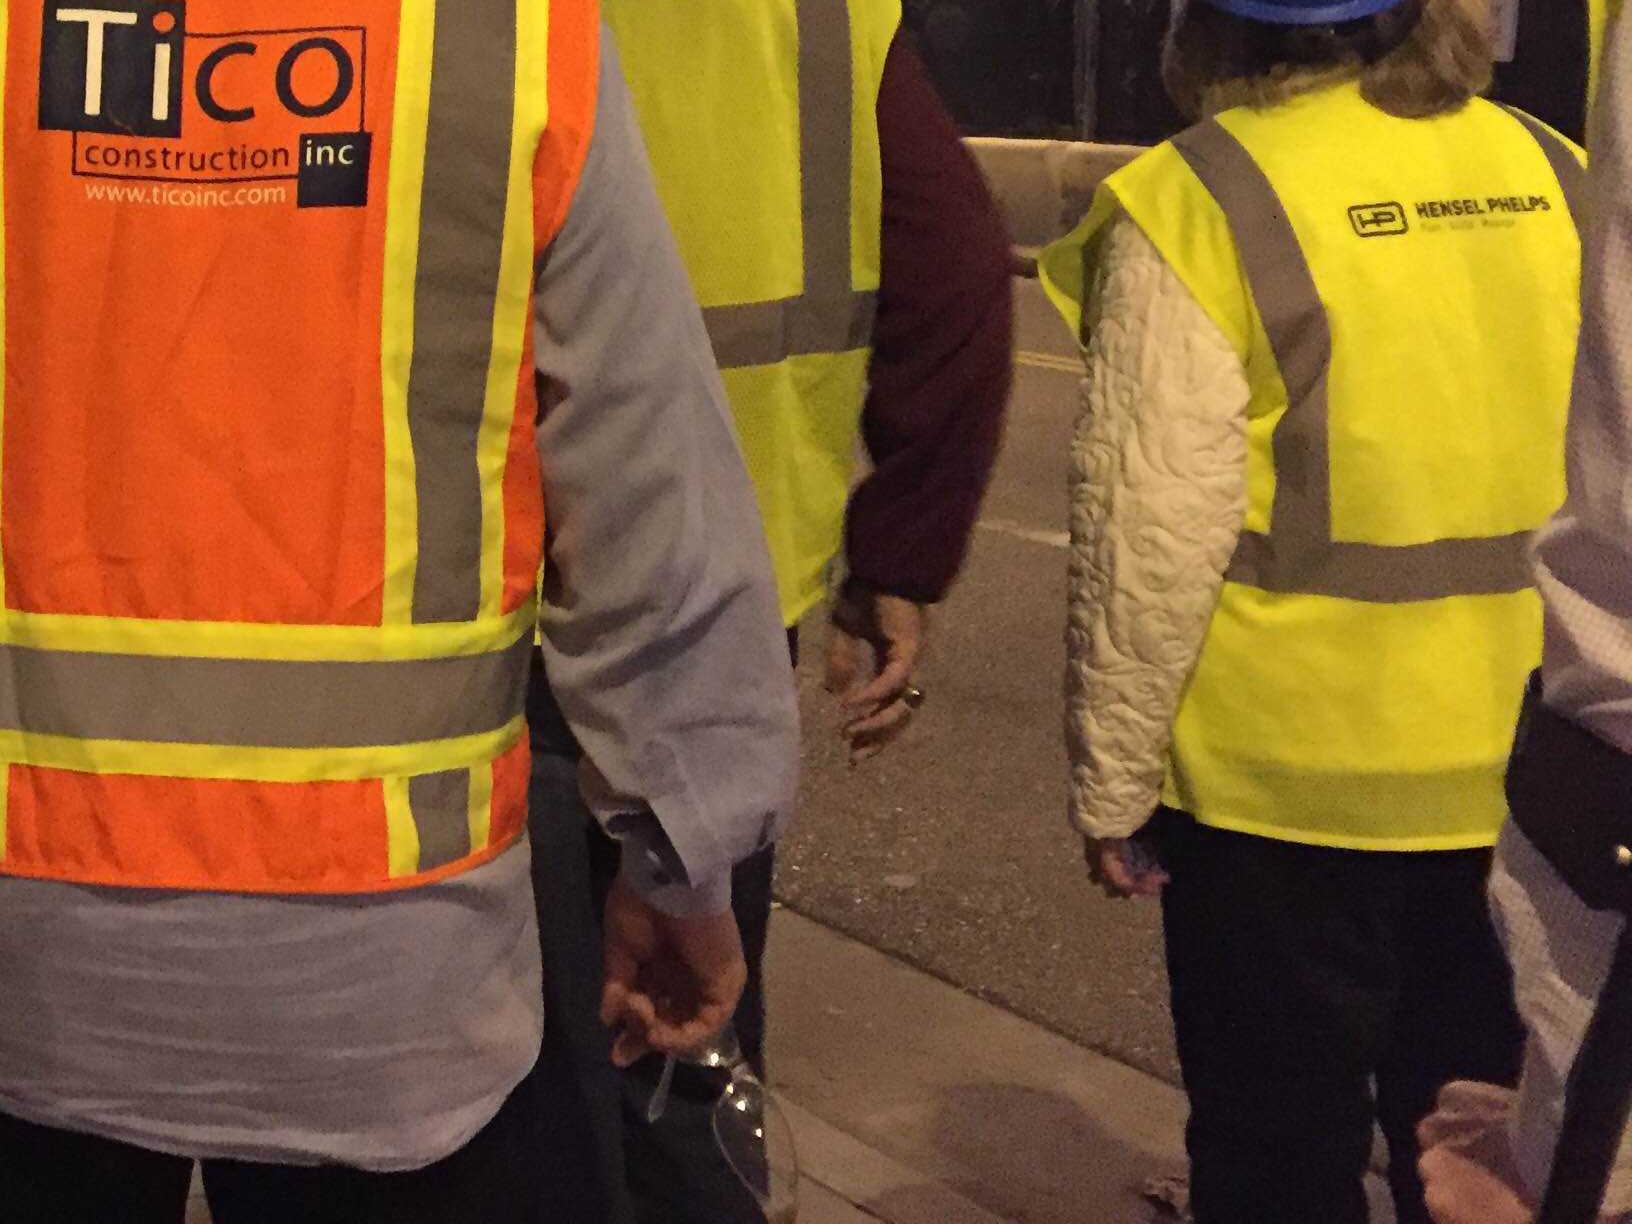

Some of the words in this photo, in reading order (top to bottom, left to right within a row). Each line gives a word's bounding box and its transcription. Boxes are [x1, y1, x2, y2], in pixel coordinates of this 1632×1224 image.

[85, 142, 290, 173] construction
[304, 139, 355, 167] inc
[85, 182, 286, 209] www.ticoinc.com
[1415, 199, 1484, 218] HENSEL
[1487, 195, 1551, 214] PHELPS
